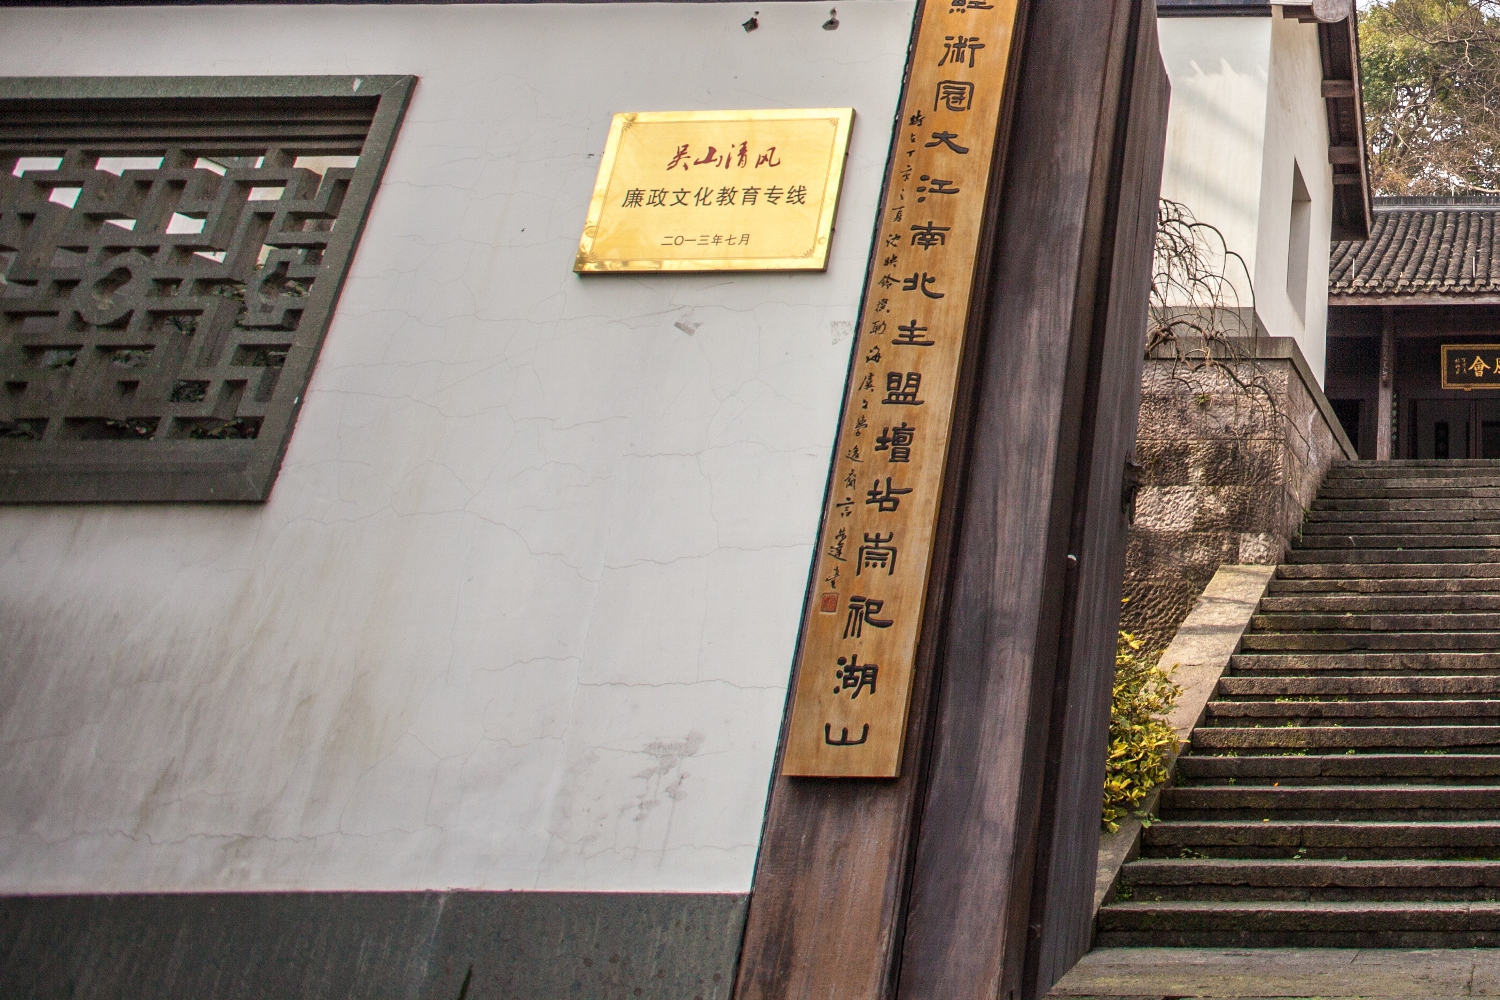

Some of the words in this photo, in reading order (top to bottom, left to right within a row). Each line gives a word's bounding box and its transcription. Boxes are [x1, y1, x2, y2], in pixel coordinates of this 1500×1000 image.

[621, 185, 808, 209] 廉政文化教育专线
